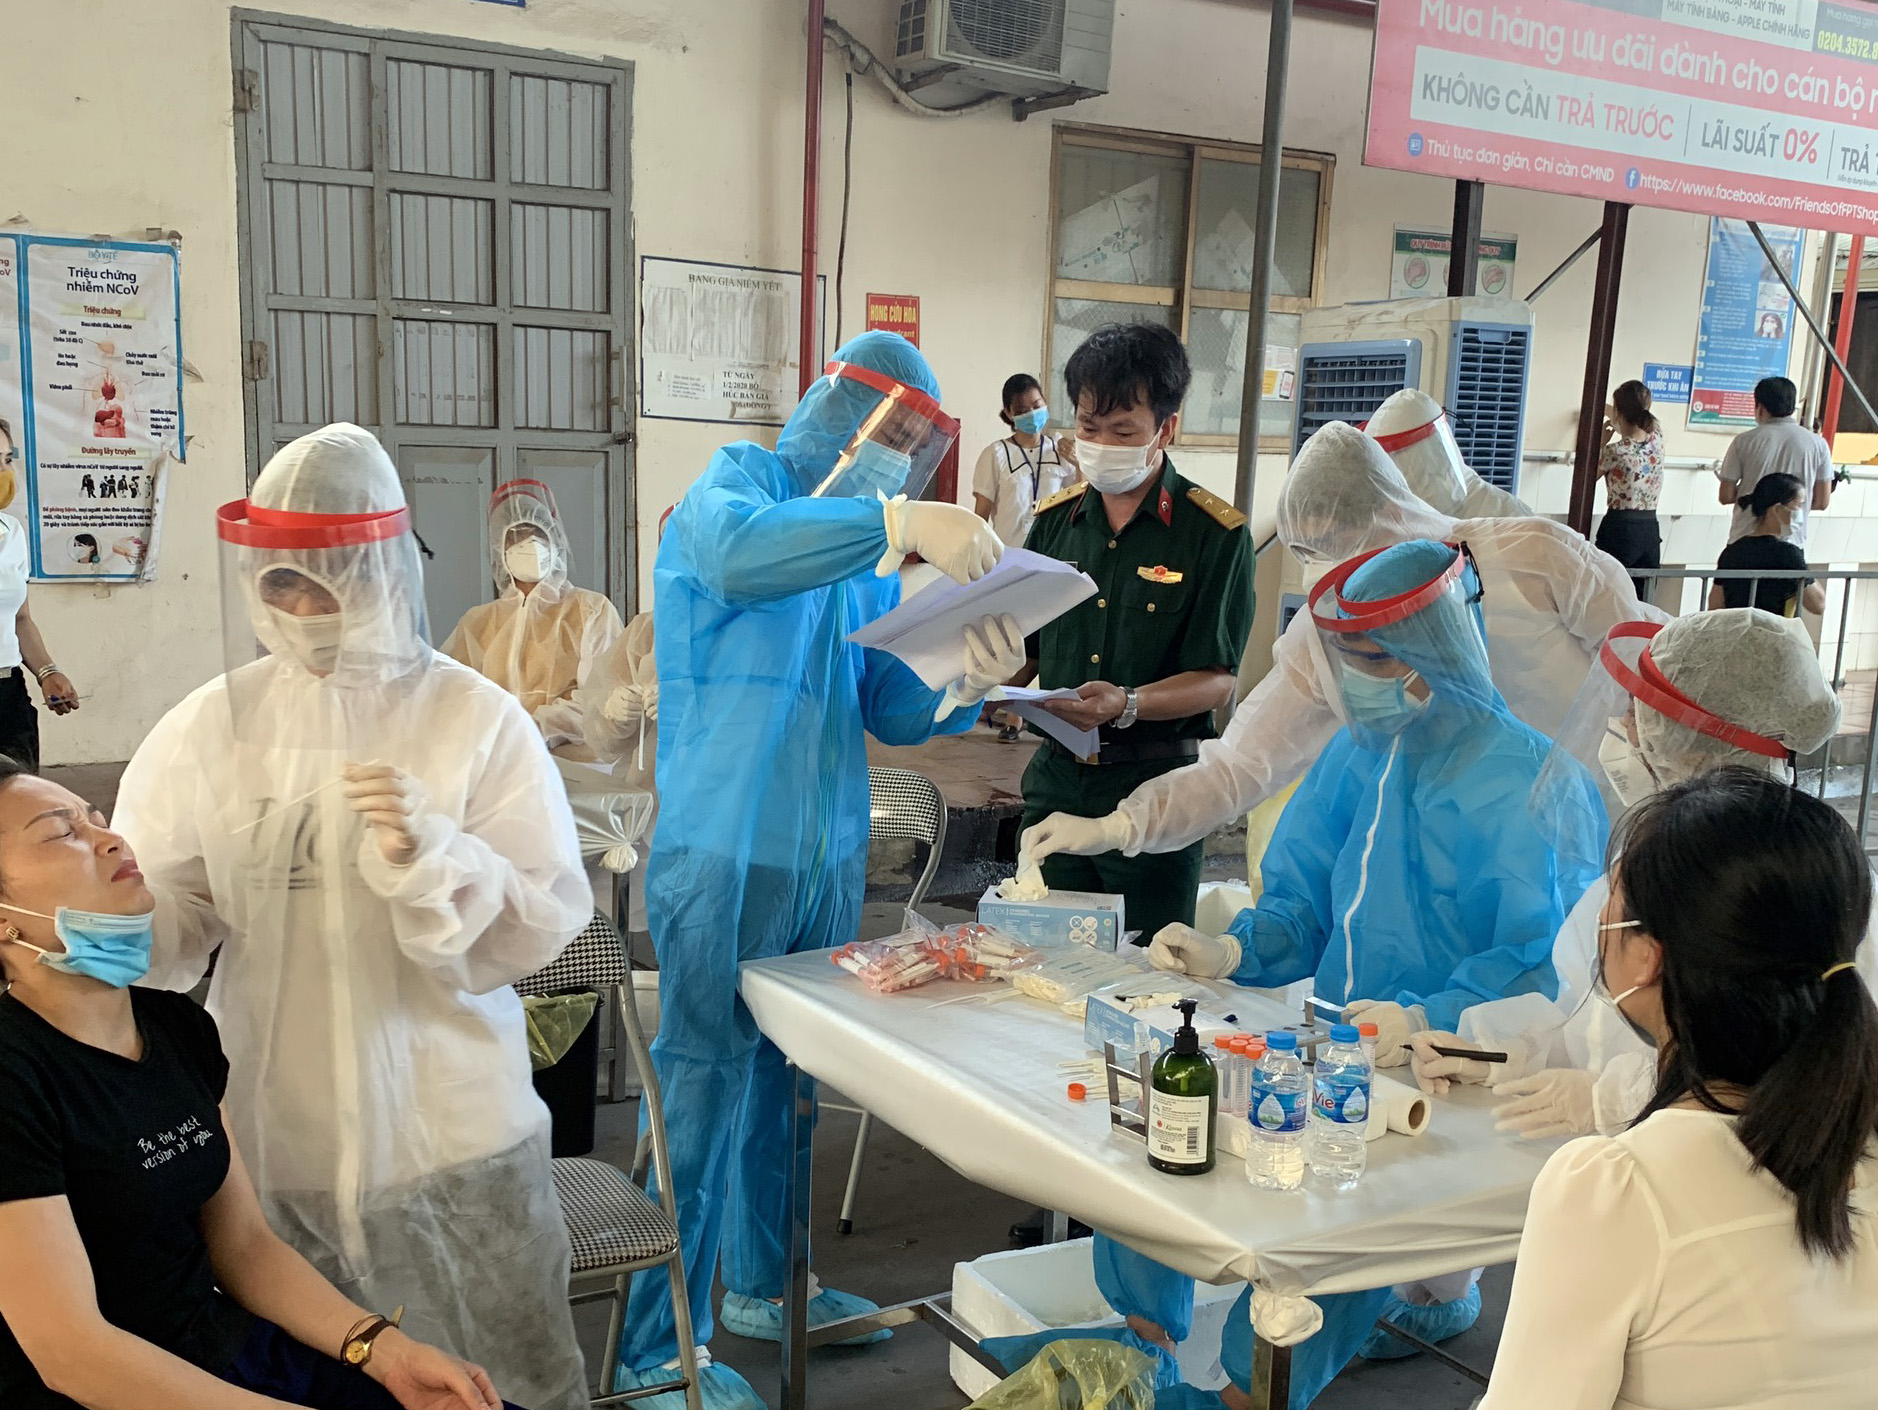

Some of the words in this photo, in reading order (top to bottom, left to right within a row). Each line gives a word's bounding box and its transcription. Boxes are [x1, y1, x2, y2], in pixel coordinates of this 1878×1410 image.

[1736, 15, 1761, 30] APPLE
[1420, 0, 1482, 38] Mua
[1490, 6, 1565, 65] hàng
[1572, 28, 1606, 62] ưu
[1612, 31, 1656, 73] đãi
[1660, 41, 1727, 86] dành
[1732, 59, 1779, 95] cho
[1784, 66, 1829, 105] cán
[1834, 75, 1865, 120] bộ
[1422, 71, 1500, 111] KHÔNG
[1505, 79, 1550, 120] CẦN
[1556, 92, 1595, 129] TRẢ
[1603, 102, 1674, 141] TRƯỚC
[1701, 119, 1730, 151] LÃI
[1733, 122, 1779, 159] SUẤT
[1783, 128, 1820, 164] 0%
[1841, 143, 1869, 174] TRẢ
[1427, 139, 1450, 157] Thủ
[1453, 145, 1472, 165] tục
[1476, 148, 1500, 166] đơn
[1556, 158, 1579, 178] cần
[1581, 164, 1615, 182] CMND
[66, 279, 104, 294] nhiễm
[107, 283, 140, 296] NCoV
[67, 266, 98, 280] Triệu
[101, 269, 137, 284] chứng
[83, 305, 100, 316] Triệu
[101, 305, 122, 317] chứng
[1670, 370, 1682, 380] TAY
[137, 1138, 156, 1153] Be
[157, 1130, 176, 1145] the
[176, 1115, 201, 1135] best
[141, 1148, 176, 1169] version
[177, 1137, 189, 1153] of
[193, 1129, 213, 1146] you
